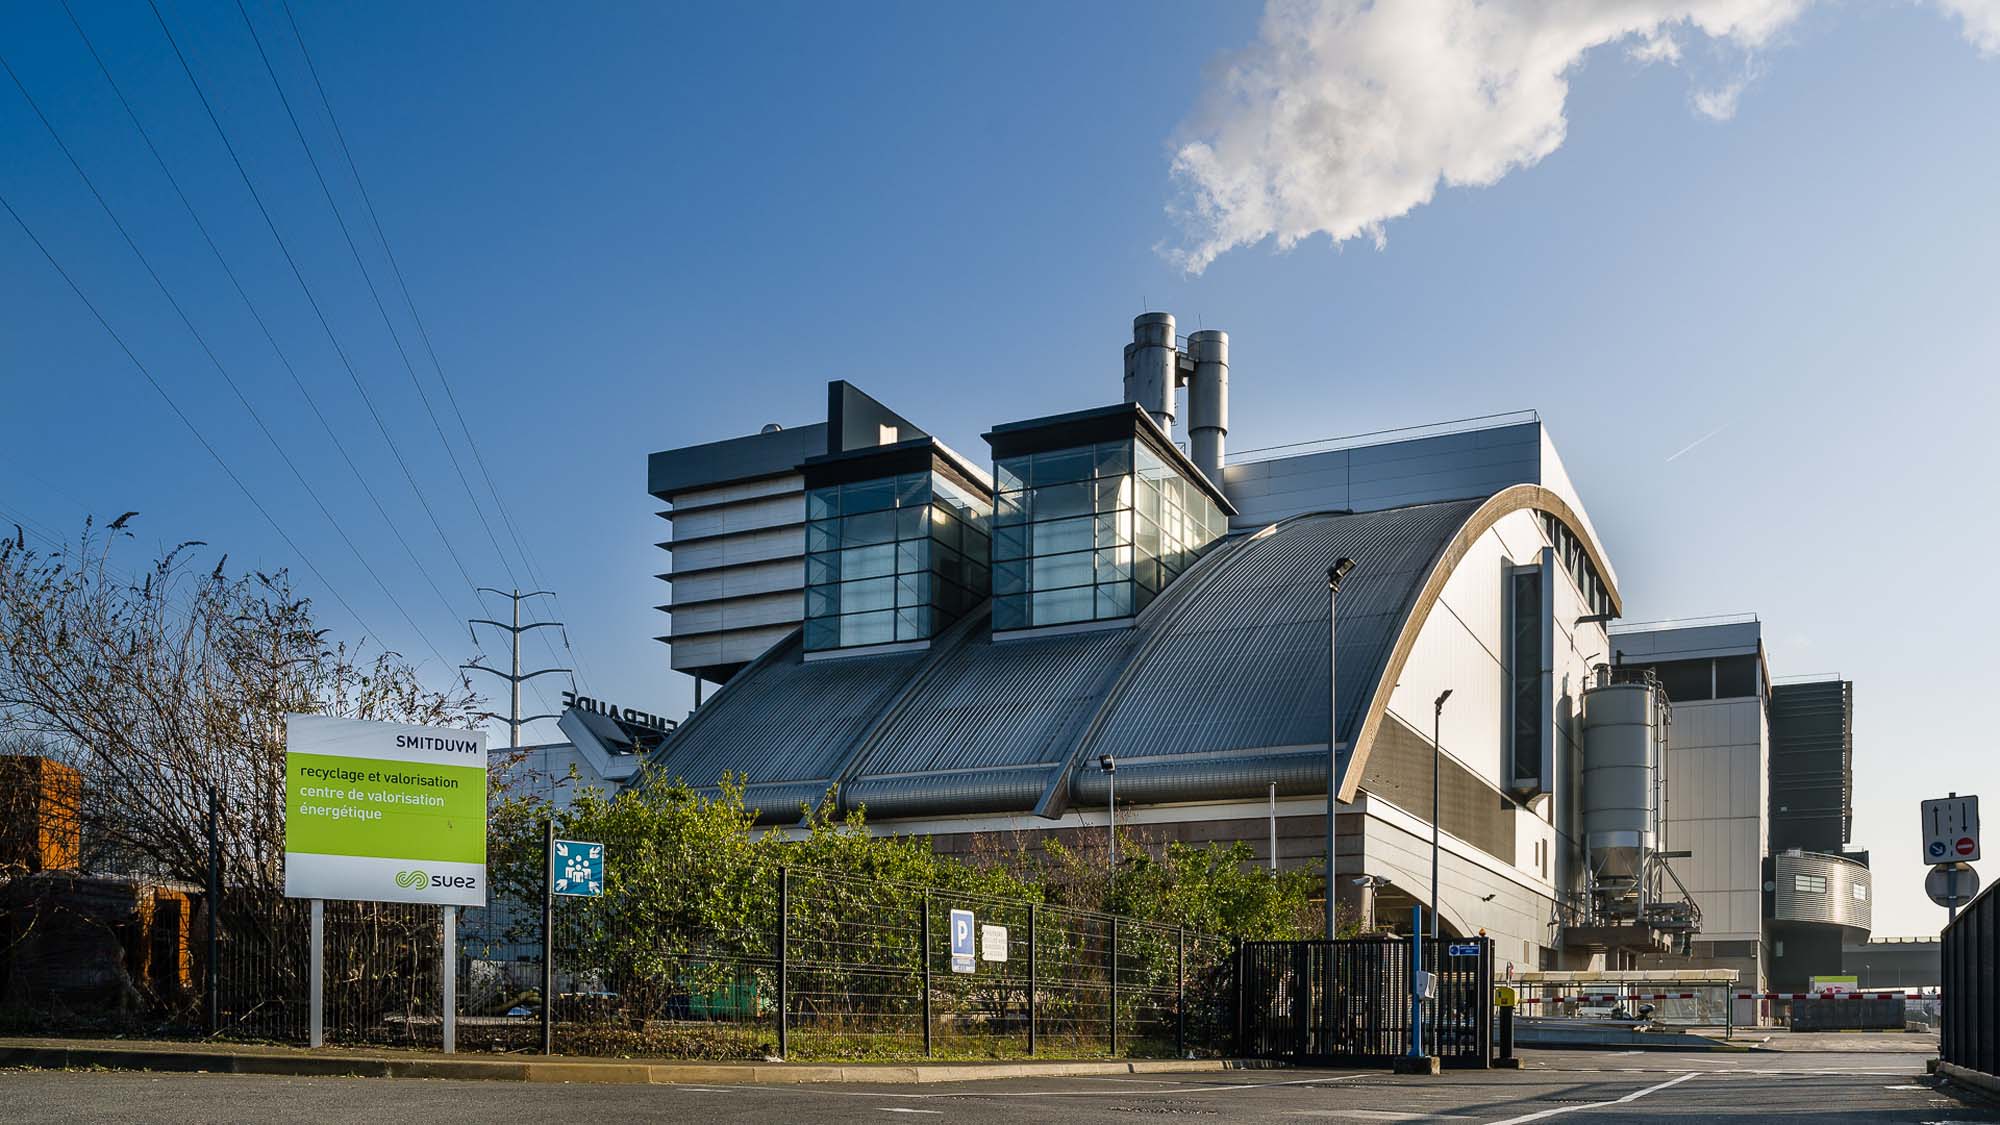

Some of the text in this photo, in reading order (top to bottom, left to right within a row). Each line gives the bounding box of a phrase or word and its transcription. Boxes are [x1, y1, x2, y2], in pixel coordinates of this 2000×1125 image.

[396, 735, 477, 754] SMITDUVM
[300, 767, 458, 788] recyclage et valorisation
[300, 786, 445, 807] centre de valorisation
[300, 802, 382, 821] énergétique
[431, 875, 476, 889] suez
[957, 920, 968, 947] P
